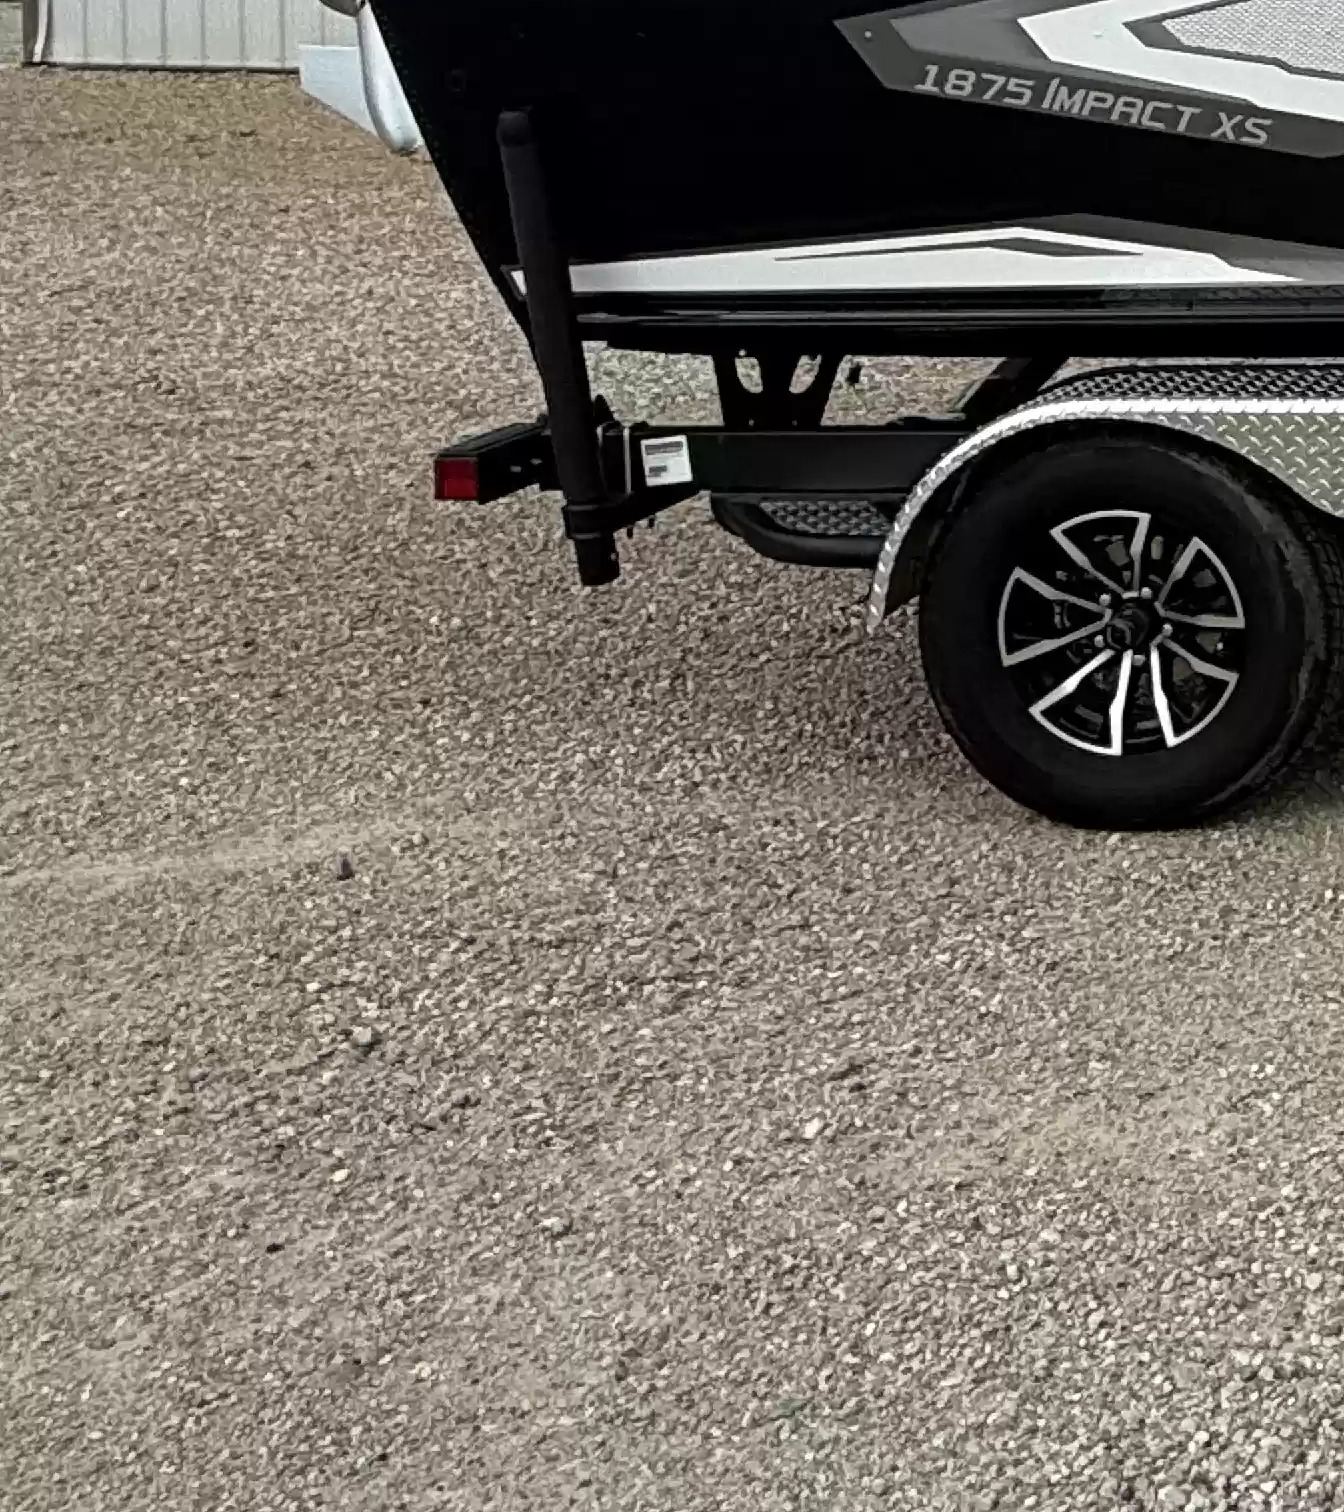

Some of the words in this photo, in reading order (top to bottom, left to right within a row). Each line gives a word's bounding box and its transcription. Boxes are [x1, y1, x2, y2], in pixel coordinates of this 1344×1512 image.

[914, 64, 1036, 106] 1875
[1041, 77, 1203, 133] IMPACT
[1210, 111, 1274, 145] XS
